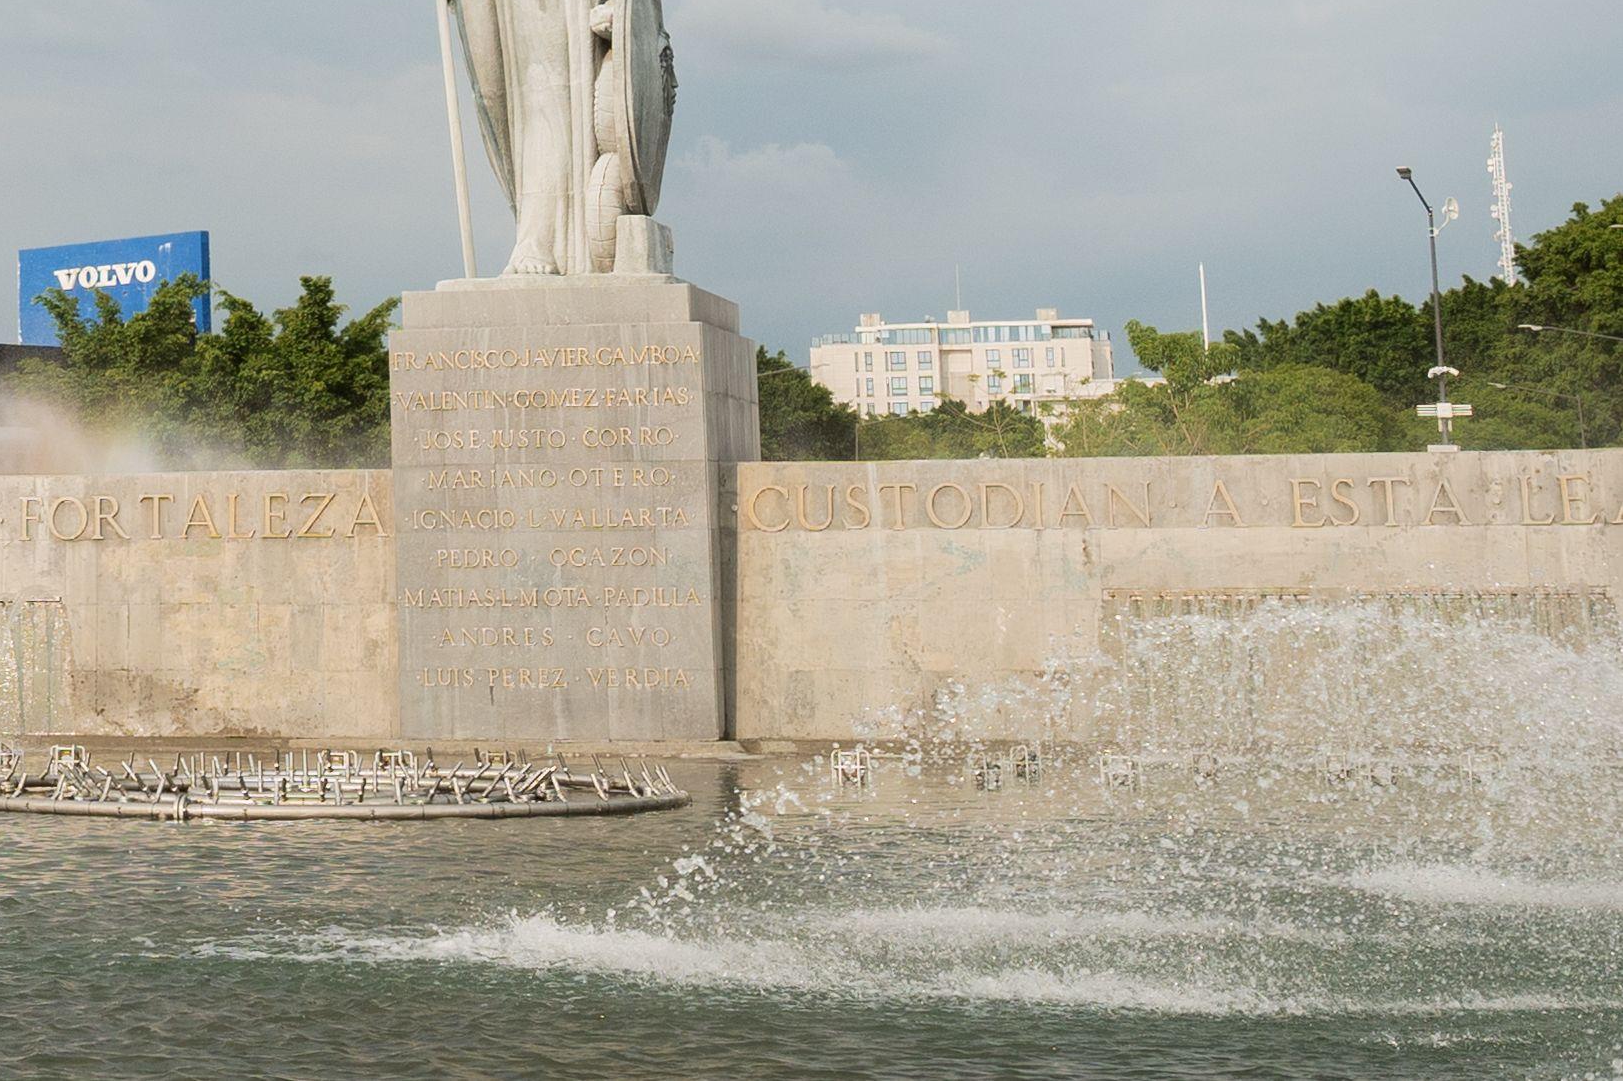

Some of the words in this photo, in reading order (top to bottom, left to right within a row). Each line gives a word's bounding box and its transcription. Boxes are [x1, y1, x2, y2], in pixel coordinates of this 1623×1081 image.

[54, 260, 156, 291] VOLVO
[392, 348, 519, 371] FRANCISCO
[520, 347, 593, 368] JAVIER
[595, 344, 699, 366] GAMBOA
[396, 389, 507, 411] VALENTIN
[513, 388, 600, 409] GOMEZ
[605, 386, 690, 407] FARIAS
[422, 430, 481, 450] JOSE
[487, 429, 567, 449] JUSTO
[582, 427, 674, 448] CORRO
[427, 469, 558, 490] MARIANO
[568, 467, 670, 488] OTERO
[748, 480, 1155, 533] CUSTODIAN
[1196, 479, 1249, 529] A
[1289, 476, 1475, 528] ESTA
[1516, 474, 1623, 528] LE
[18, 492, 390, 542] FORTALEZA
[413, 509, 516, 530] IGNACIO
[529, 509, 541, 528] L
[548, 506, 690, 528] VALLARTA
[436, 548, 519, 569] PEDRO
[549, 547, 669, 568] OGAZON
[404, 587, 496, 608] MATIAS
[518, 587, 593, 608] MOTA
[602, 586, 702, 608] PADILLA
[438, 627, 555, 648] ANDRES
[586, 627, 672, 647] CAVO
[422, 668, 474, 688] LUIS
[487, 667, 569, 688] PEREZ
[586, 667, 691, 688] VERDIA
